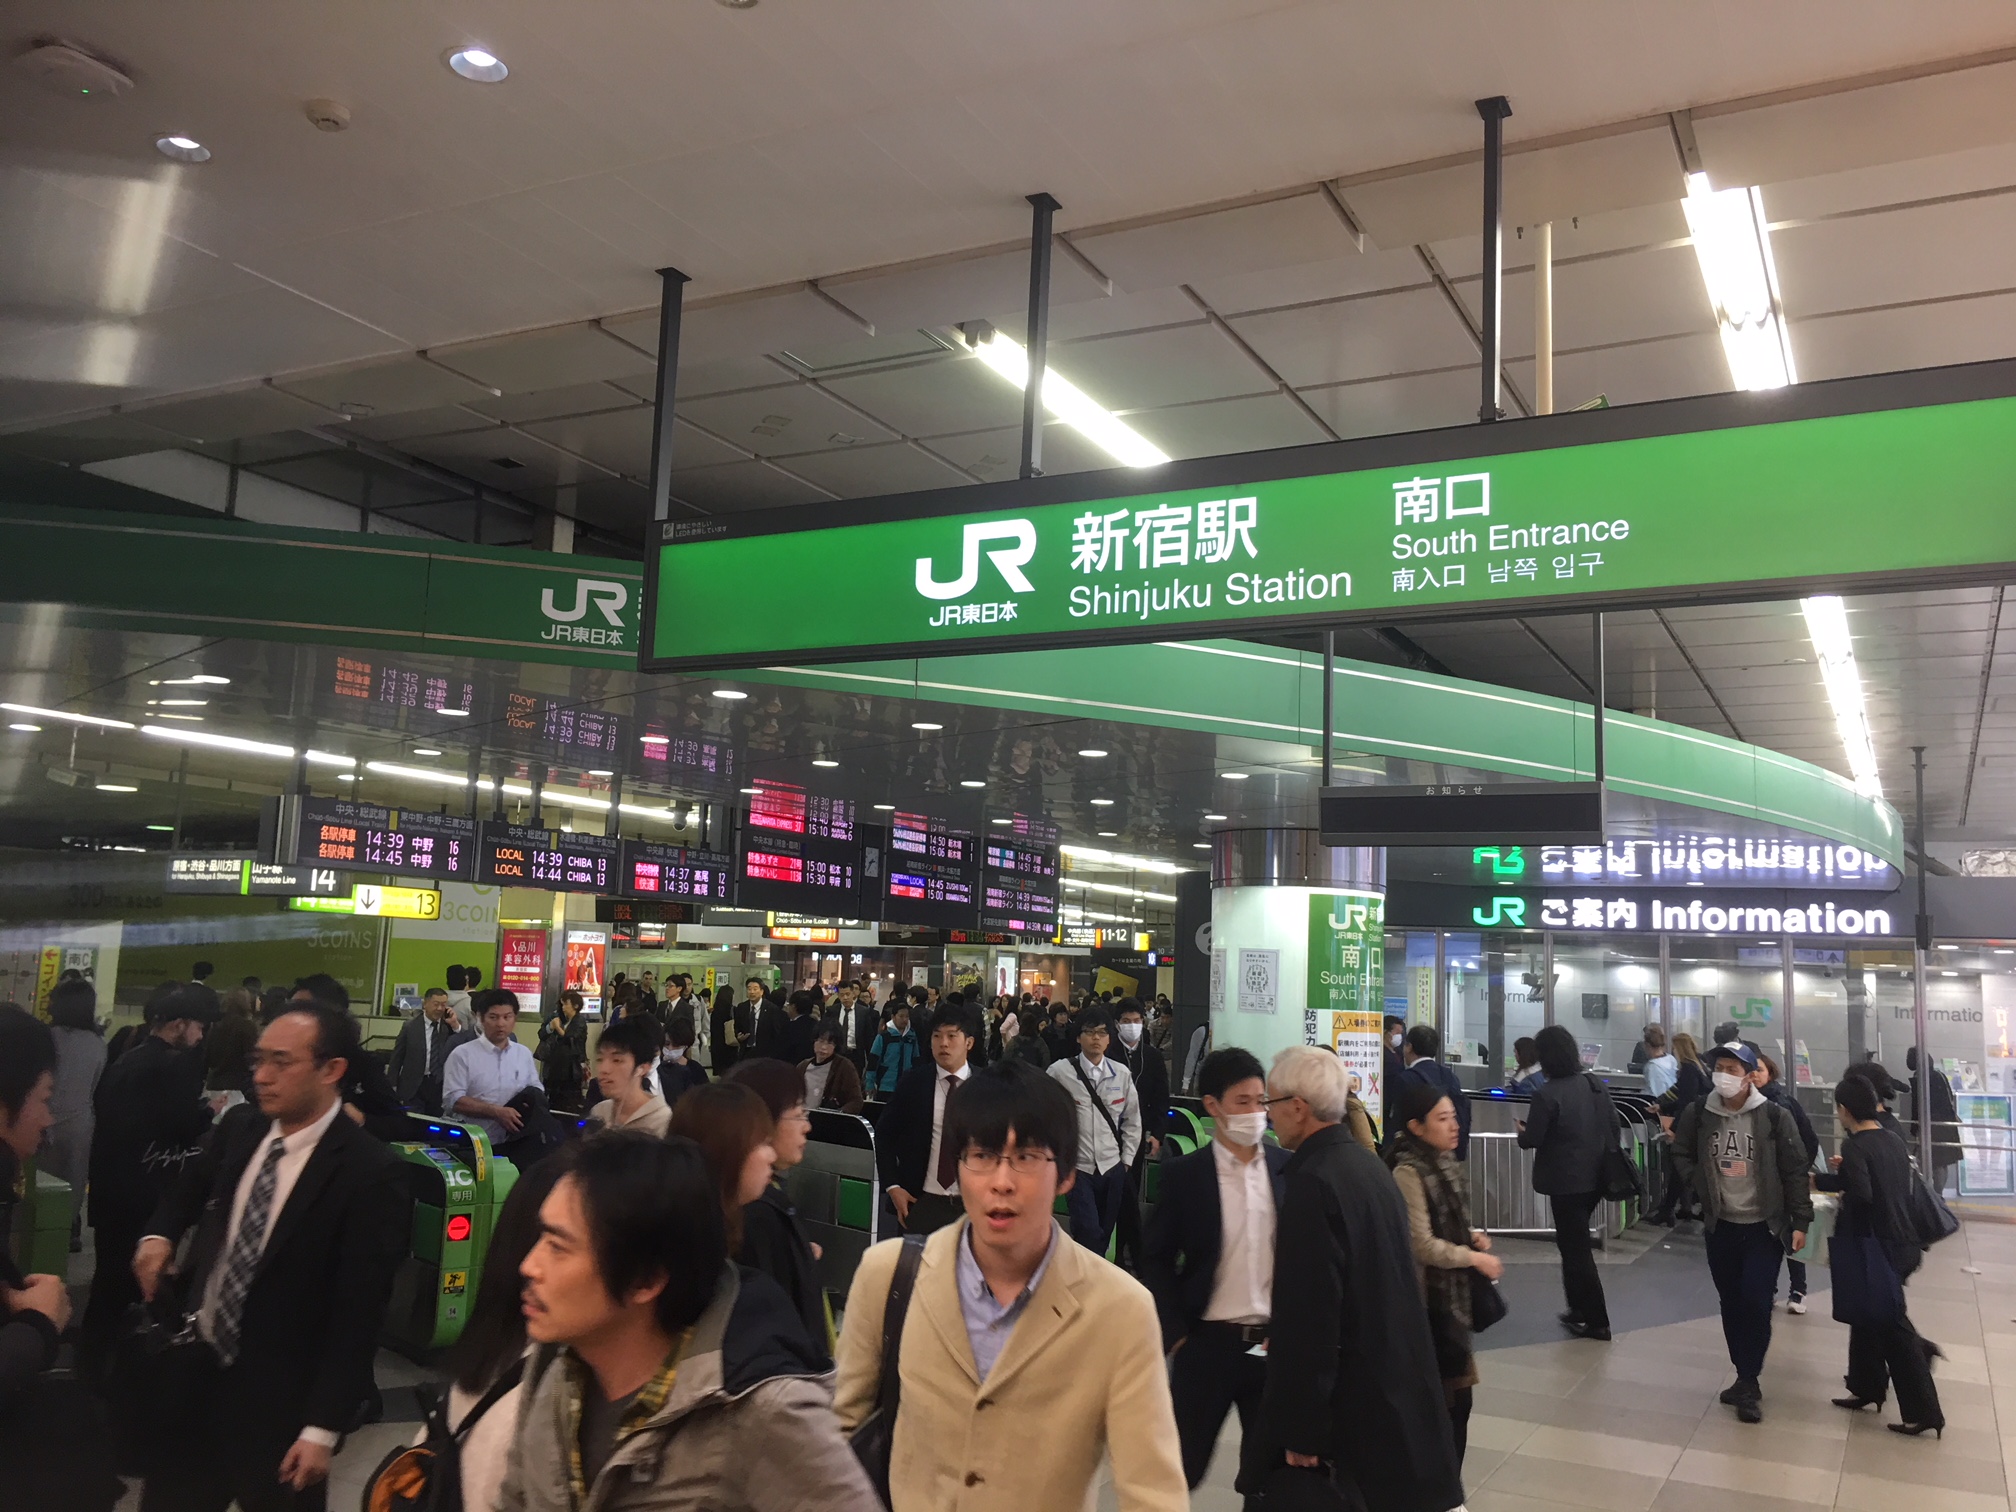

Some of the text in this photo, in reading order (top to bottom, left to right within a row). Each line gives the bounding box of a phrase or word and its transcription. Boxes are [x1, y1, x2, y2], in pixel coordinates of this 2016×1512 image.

[1392, 471, 1491, 526] 南口
[1070, 496, 1259, 575] 新宿駅
[1392, 517, 1630, 561] South Entrance
[915, 518, 1037, 600] JR
[1392, 552, 1605, 592] 南入口 남쪽 입구
[541, 578, 628, 627] JR
[1068, 572, 1352, 619] Shinjuku Station
[929, 600, 1018, 627] JR東日本
[541, 624, 624, 646] JR東日本
[1425, 785, 1484, 796] お知らせ
[808, 823, 828, 837] 15:10
[847, 831, 853, 842] 6
[320, 825, 357, 843] 各駅停車
[366, 830, 405, 849] 14:39
[411, 837, 434, 853] 中野
[449, 840, 459, 855] 16
[929, 835, 946, 847] 14:50
[318, 842, 458, 872] 各駅停車 14:45 中野 16
[496, 847, 607, 872] LOCAL 14:39 CHIBA 13
[929, 845, 945, 857] 15:06
[495, 863, 606, 886] LOCAL 14:44 CHIBA 13
[665, 866, 690, 880] 14:37
[718, 872, 725, 884] 12
[806, 860, 827, 873] 15:00
[252, 875, 282, 884] Yamanote
[283, 876, 297, 885] Line
[310, 868, 336, 891] 14
[806, 872, 826, 885] 15:30
[928, 878, 944, 890] 14:45
[664, 880, 690, 894] 14:39
[717, 885, 725, 898] 12
[928, 889, 944, 900] 15:00
[416, 894, 435, 916] 13
[443, 902, 500, 921] 3COIN
[1329, 904, 1367, 931] JR
[1473, 897, 1891, 935] JR ご案内 Information
[308, 926, 374, 950] 3COINS
[1335, 932, 1364, 940] JR東日本
[518, 942, 536, 954] 品川
[504, 954, 541, 965] 美容外科
[1342, 945, 1381, 970] 南口
[1320, 971, 1357, 985] South
[1330, 989, 1357, 1001] 南入口
[1894, 1006, 1983, 1022] Infrmatio
[446, 1169, 474, 1187] IC
[452, 1190, 473, 1202] 専用
